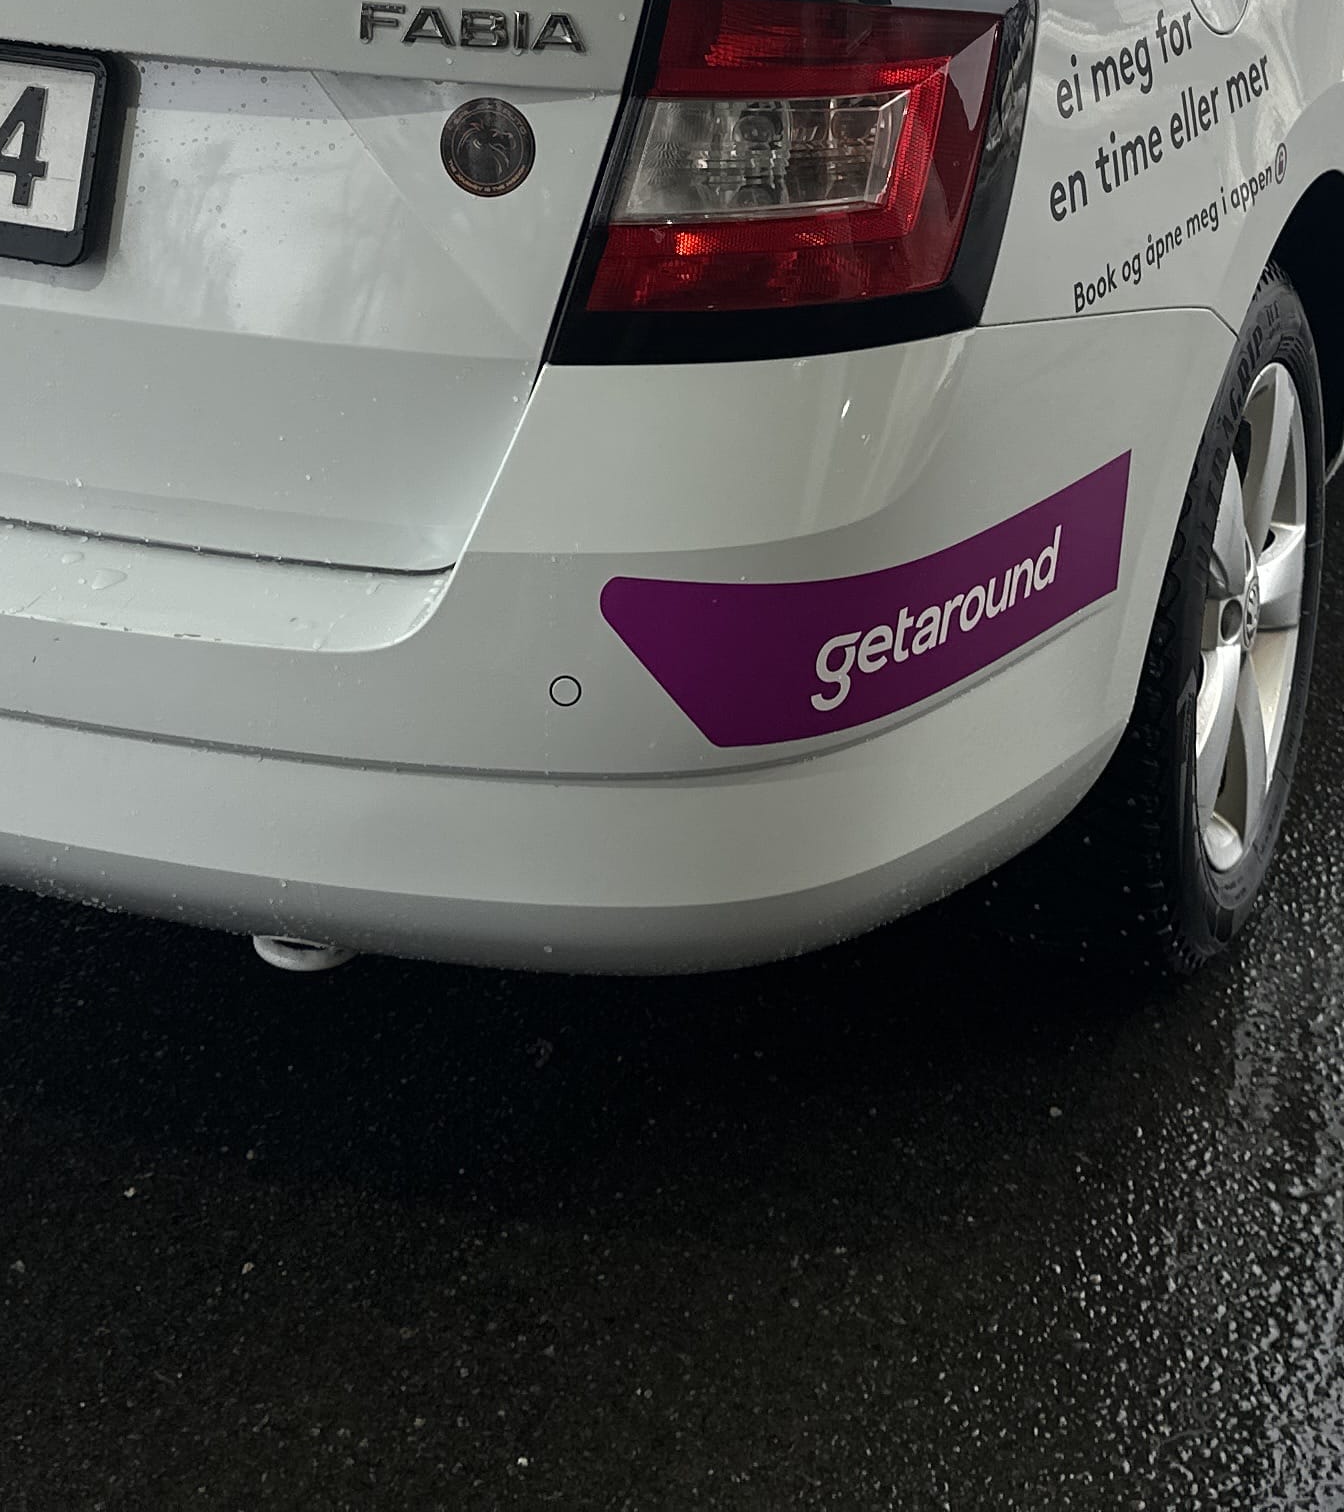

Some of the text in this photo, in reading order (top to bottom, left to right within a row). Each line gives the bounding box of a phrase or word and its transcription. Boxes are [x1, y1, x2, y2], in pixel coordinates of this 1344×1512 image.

[359, 1, 586, 54] FABIA
[1056, 9, 1192, 119] ei meg for
[1050, 55, 1269, 222] en time eller mer
[1073, 166, 1272, 313] Book og åpne meg i appen
[810, 524, 1062, 712] getaround
